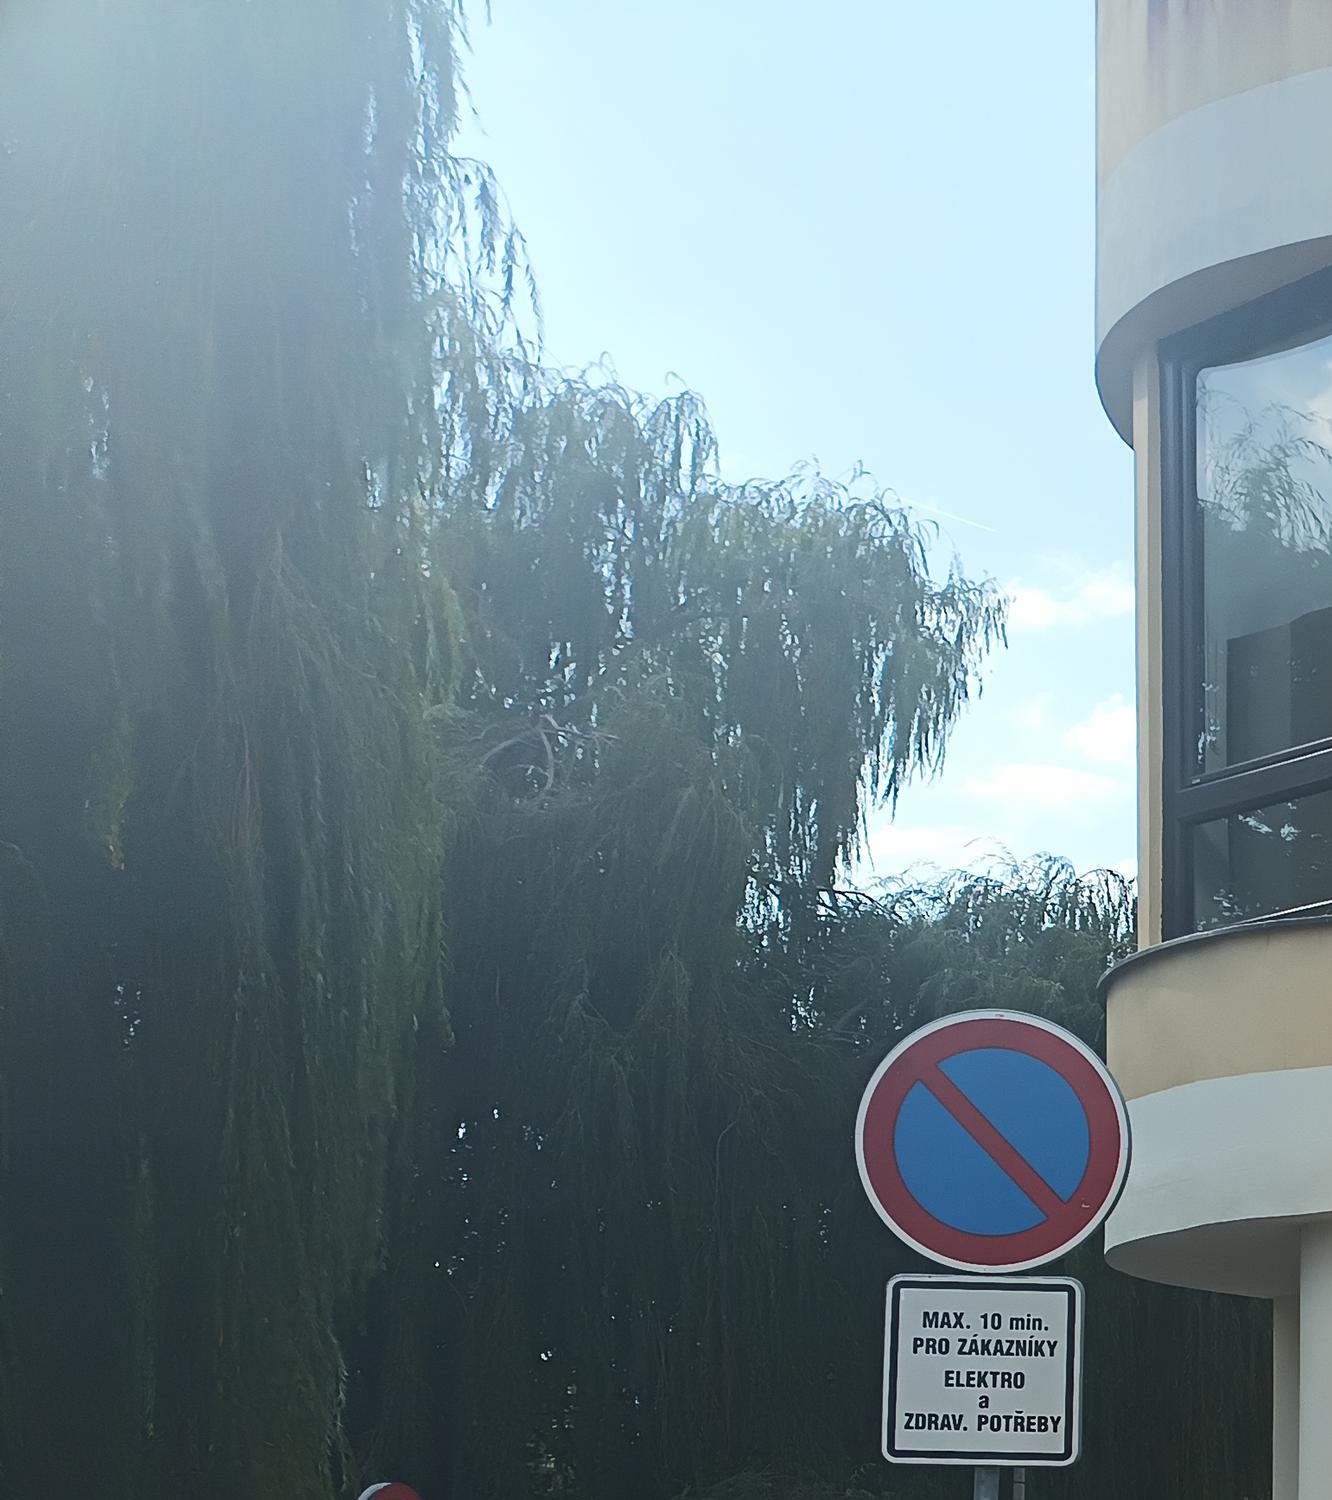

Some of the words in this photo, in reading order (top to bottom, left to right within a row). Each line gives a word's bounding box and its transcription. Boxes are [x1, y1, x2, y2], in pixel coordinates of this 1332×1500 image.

[922, 1311, 971, 1330] MAX.
[980, 1312, 1002, 1331] 10
[1009, 1312, 1049, 1331] min.
[912, 1336, 950, 1356] PRO
[957, 1332, 1058, 1357] ZÁKAZNÍKY
[944, 1370, 1025, 1389] ELEKTRO
[978, 1395, 989, 1409] a
[904, 1412, 968, 1432] ZDRAV.
[977, 1410, 1061, 1434] POTŘEBY
